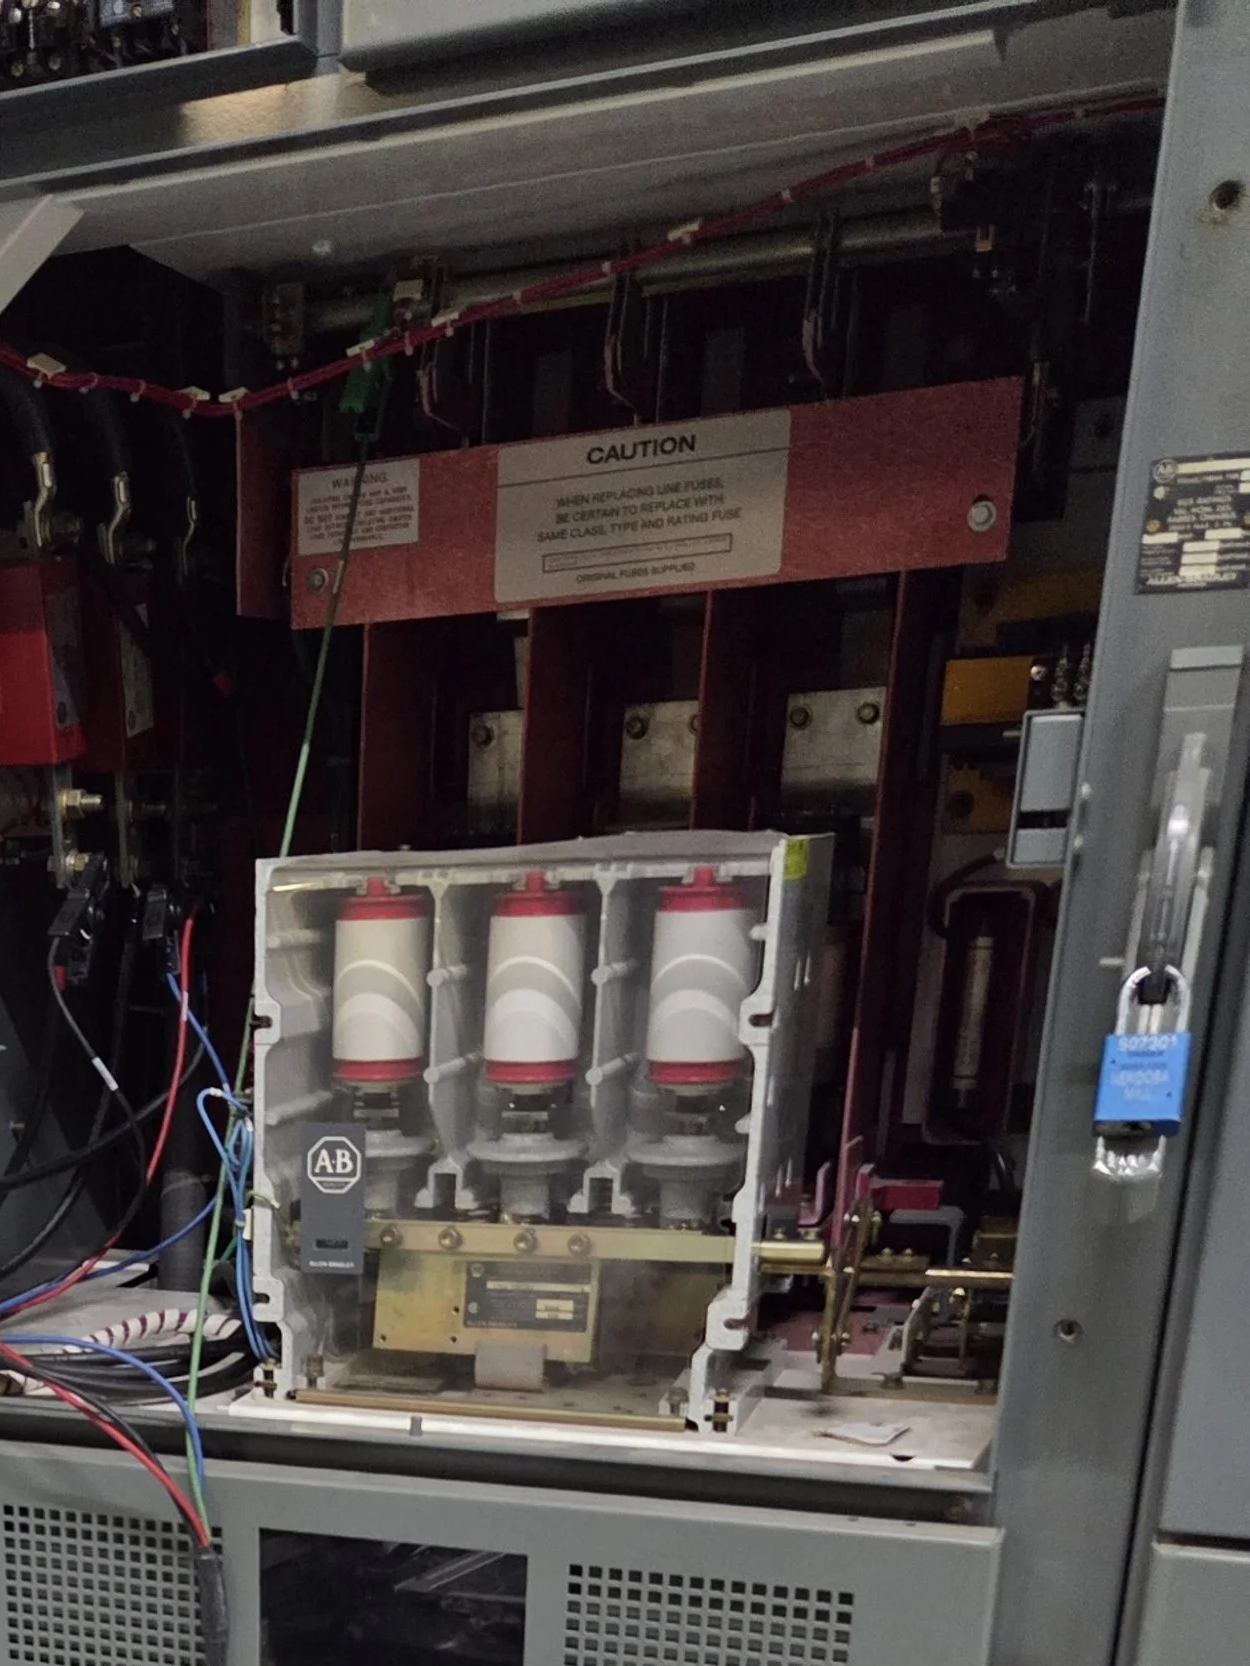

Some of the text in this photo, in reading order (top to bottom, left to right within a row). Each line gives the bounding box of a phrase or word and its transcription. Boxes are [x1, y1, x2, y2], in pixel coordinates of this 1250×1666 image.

[587, 434, 698, 466] CAUTION
[556, 492, 589, 508] WHEN
[592, 486, 654, 502] REPLACING
[656, 482, 681, 497] LINE
[537, 530, 568, 543] SAME
[610, 520, 638, 534] TYPE
[641, 516, 665, 530] AND
[668, 512, 708, 526] RATING
[712, 507, 742, 521] FUSE
[555, 510, 569, 524] BE
[572, 506, 620, 524] CERTAIN
[623, 503, 638, 516] TO
[640, 498, 691, 515] REPLACE
